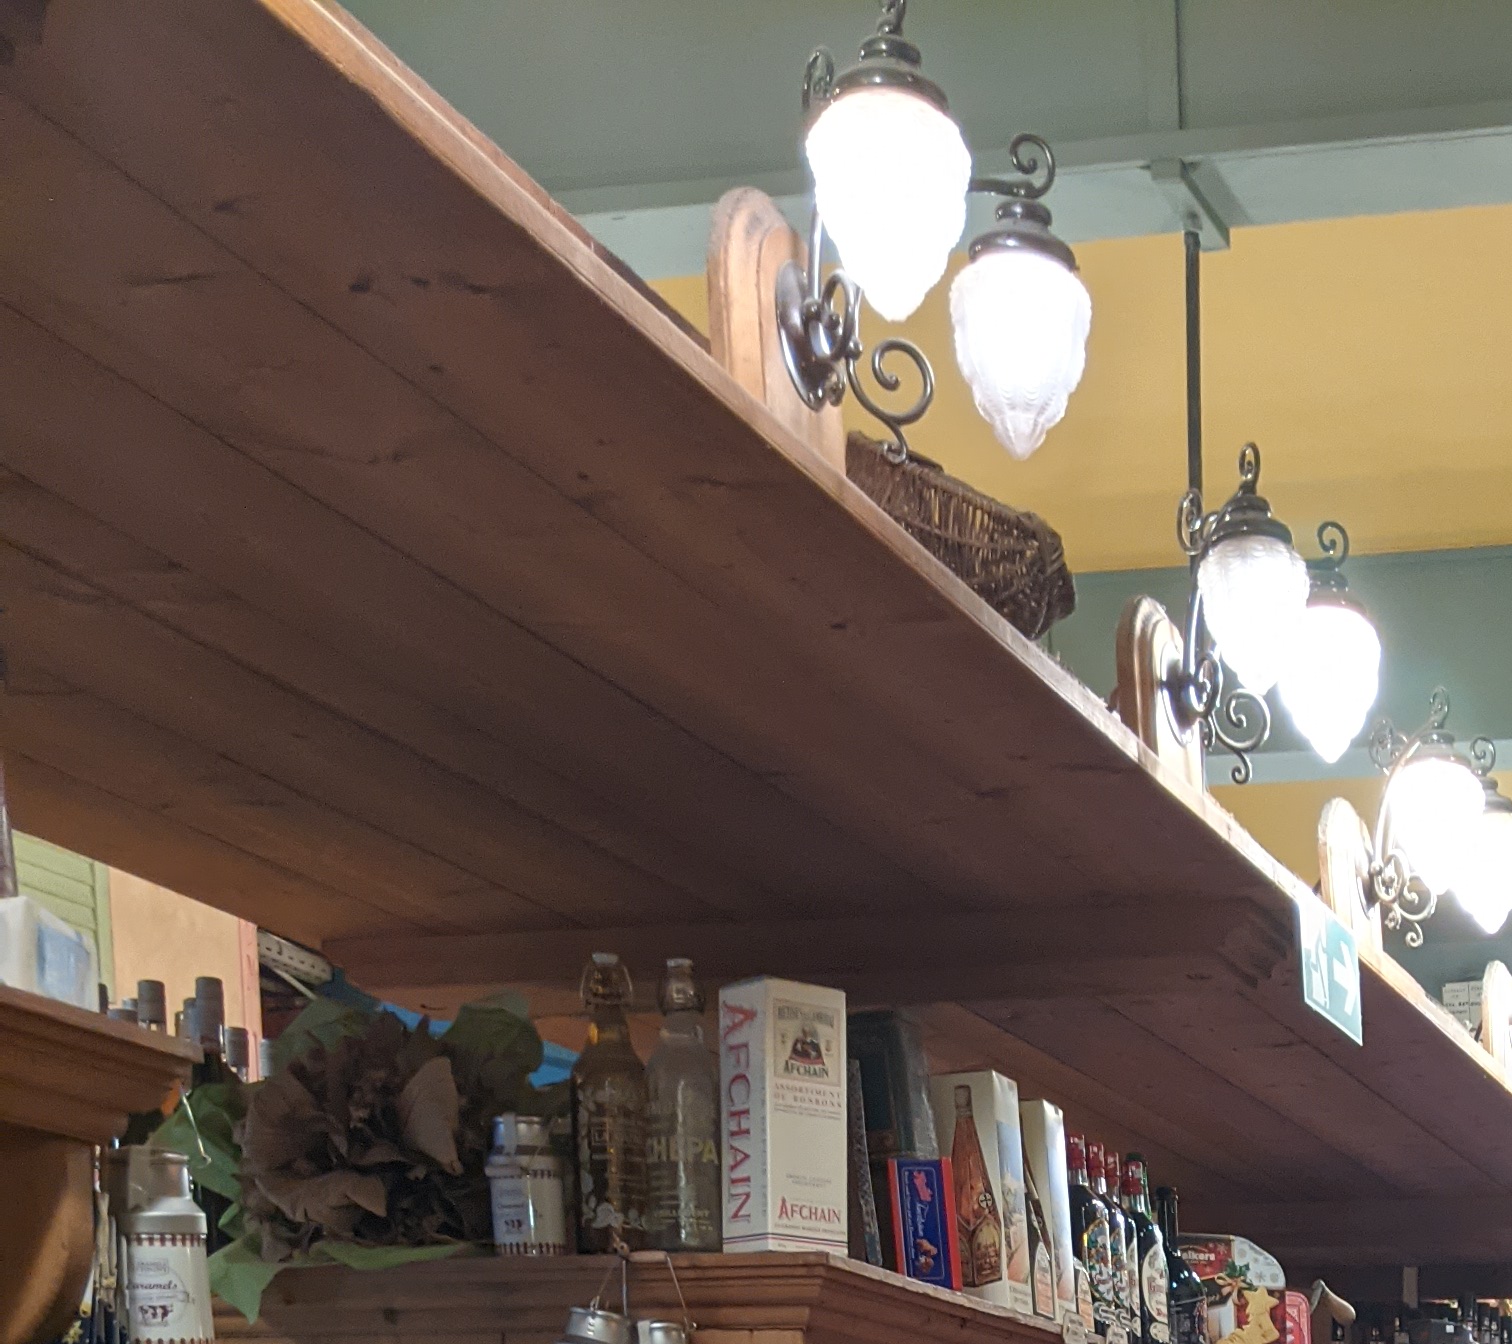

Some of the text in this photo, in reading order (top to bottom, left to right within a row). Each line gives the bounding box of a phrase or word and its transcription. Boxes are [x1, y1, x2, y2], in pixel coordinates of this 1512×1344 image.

[783, 1059, 829, 1078] AFCHAIN
[723, 1000, 758, 1223] AFCHAIN
[778, 1196, 842, 1224] AFCHAIN
